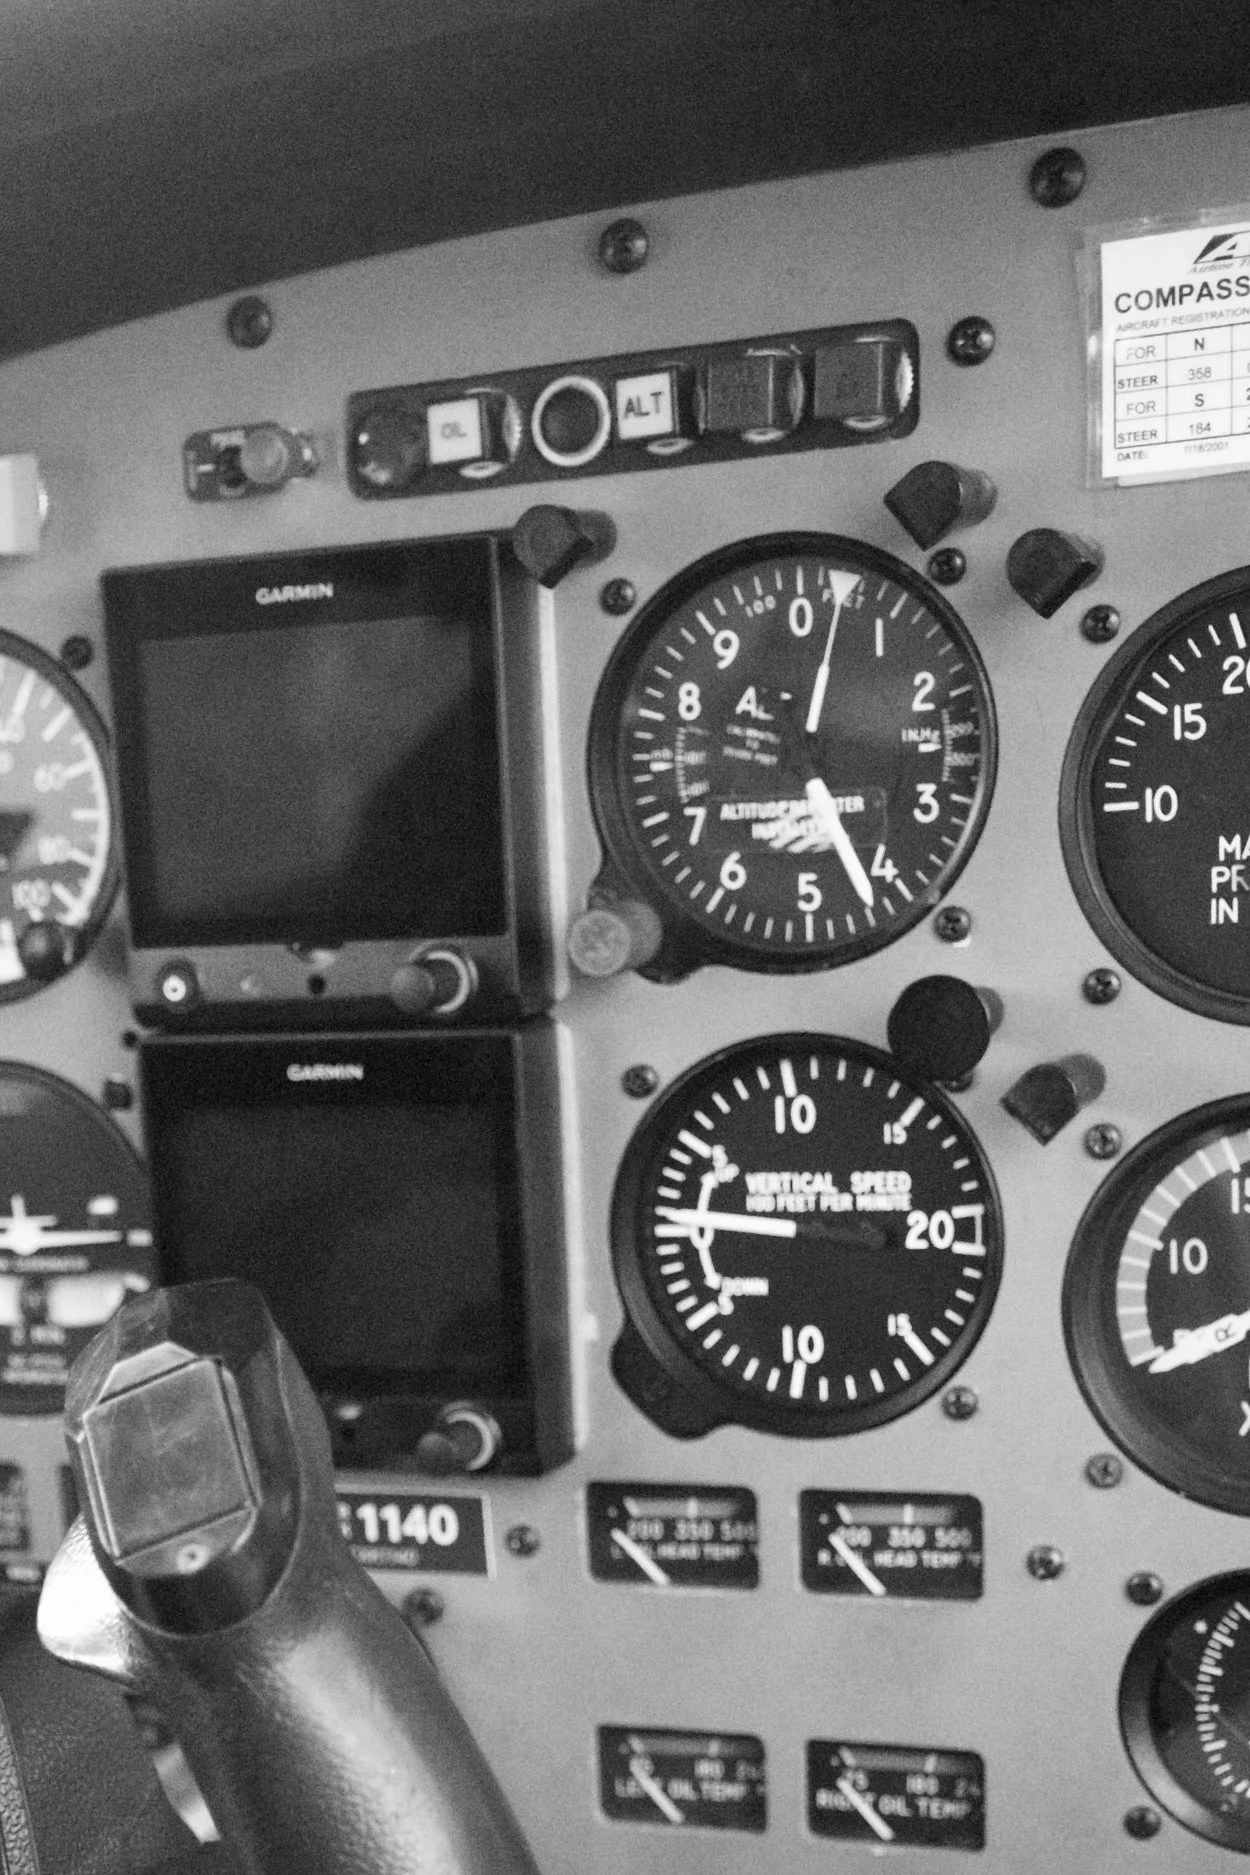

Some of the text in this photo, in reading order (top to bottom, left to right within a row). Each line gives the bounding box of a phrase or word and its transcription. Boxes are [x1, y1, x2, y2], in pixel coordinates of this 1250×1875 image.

[1114, 275, 1250, 314] COMPASS
[1116, 318, 1168, 333] AIRCRAFT
[1126, 337, 1205, 360] FOR N
[1117, 375, 1158, 389] STEER
[623, 391, 662, 419] ALT
[1126, 393, 1205, 415] FOR S
[1117, 429, 1158, 443] STEER
[255, 582, 334, 605] GARMIN
[789, 596, 814, 638] 0
[713, 629, 740, 670] 9
[912, 671, 936, 712] 2
[1222, 655, 1250, 695] 2
[678, 682, 701, 721] 8
[1173, 703, 1207, 741] 15
[913, 783, 940, 824] 3
[1145, 784, 1179, 824] 10
[683, 806, 707, 846] 7
[720, 851, 747, 891] 6
[871, 843, 899, 883] 4
[797, 872, 823, 913] 5
[1211, 896, 1239, 925] IN
[286, 1063, 364, 1082] GARMIN
[775, 1094, 817, 1134] 10
[883, 1121, 908, 1145] 15
[745, 1170, 913, 1194] VERTICAL SPEED
[905, 1209, 955, 1250] 20
[1169, 1238, 1208, 1274] 10
[782, 1324, 825, 1363] 10
